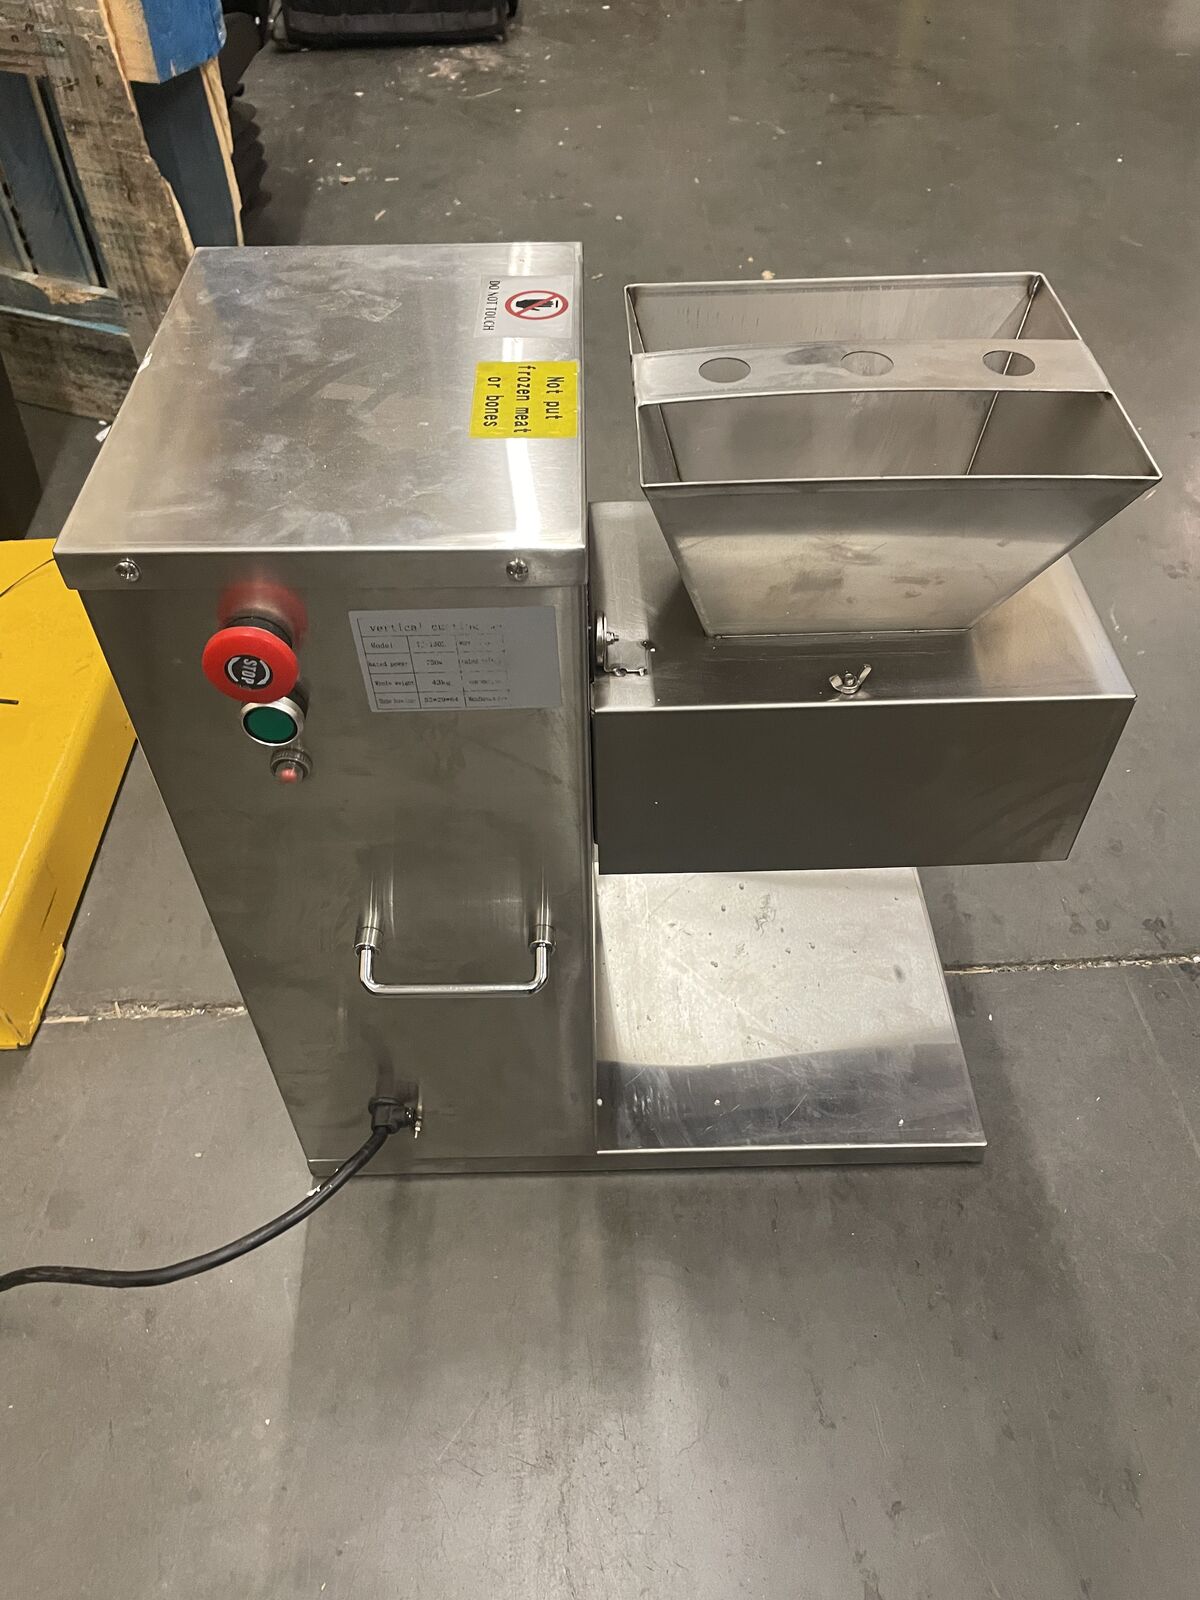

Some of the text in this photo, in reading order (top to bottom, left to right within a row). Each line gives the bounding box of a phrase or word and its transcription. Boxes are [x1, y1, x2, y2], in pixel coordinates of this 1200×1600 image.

[486, 292, 499, 305] NOT
[489, 280, 501, 290] DO
[483, 376, 504, 427] or bones
[513, 365, 536, 433] frozen meat
[543, 376, 565, 420] Not put
[241, 658, 258, 685] STOP
